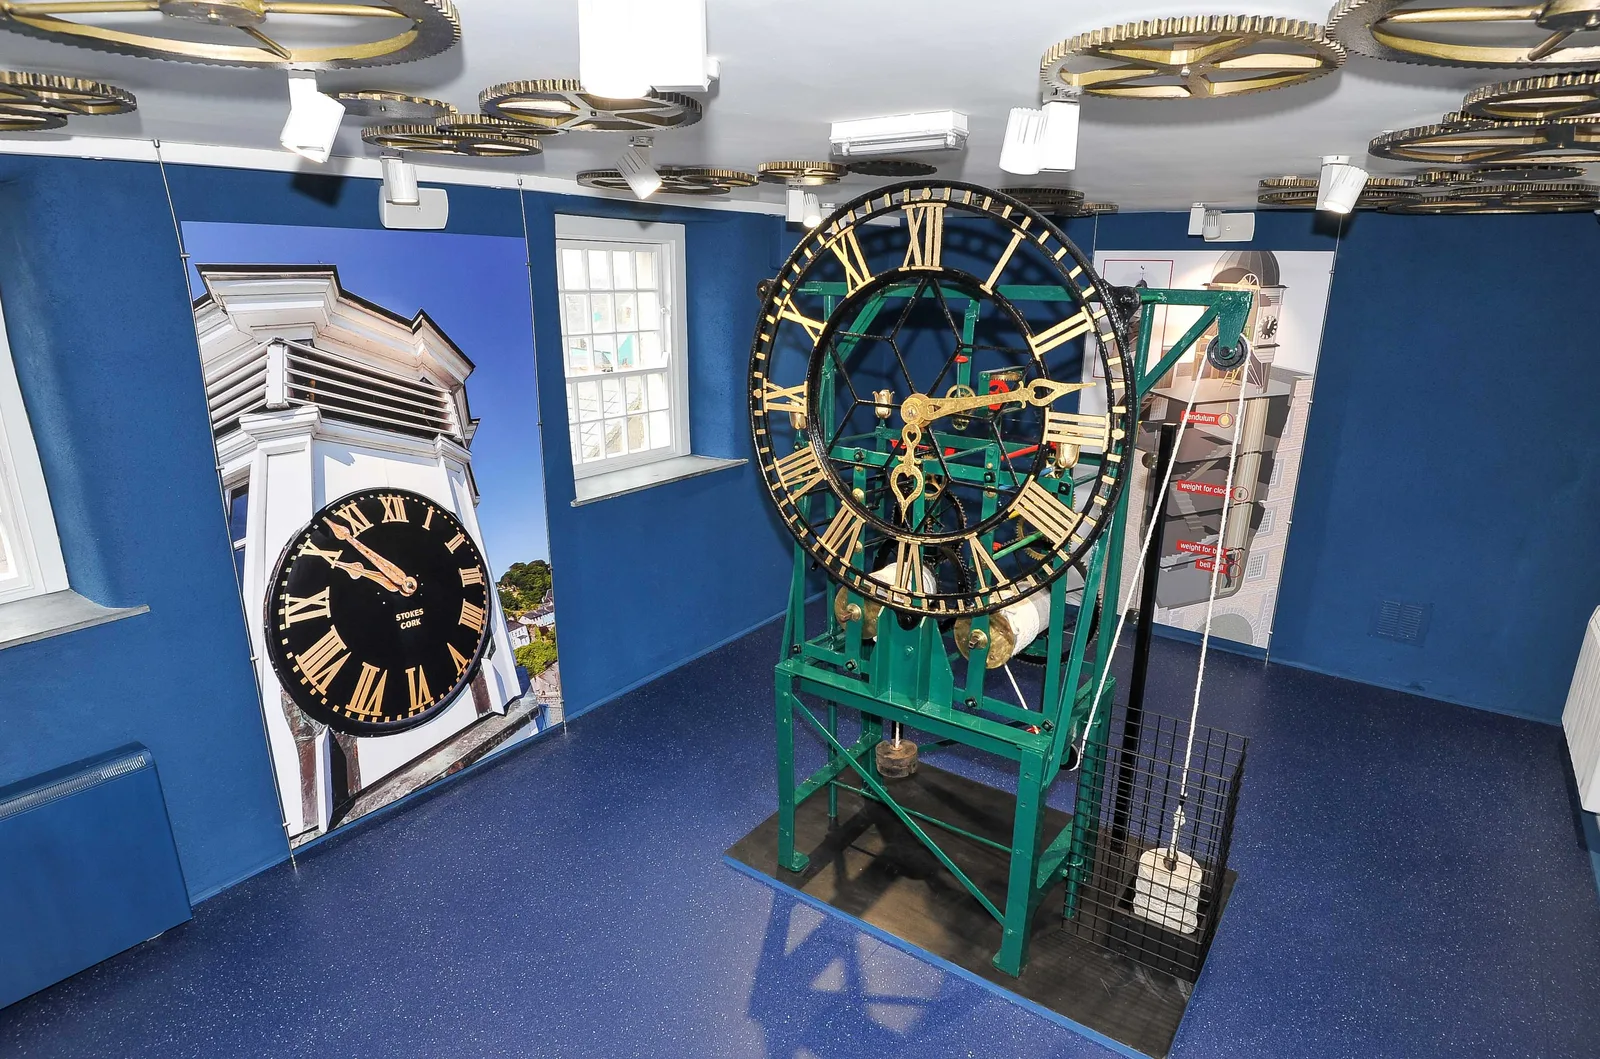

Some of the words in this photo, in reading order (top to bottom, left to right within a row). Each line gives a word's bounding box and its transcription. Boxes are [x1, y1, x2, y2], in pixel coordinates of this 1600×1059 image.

[898, 203, 947, 271] XII
[1184, 413, 1215, 423] endulum
[1181, 482, 1203, 492] weight
[1203, 484, 1213, 493] for
[377, 496, 410, 524] XII
[1180, 542, 1202, 553] weight
[1202, 545, 1212, 553] for
[1199, 560, 1211, 569] bell
[395, 608, 424, 622] STOKES
[400, 618, 422, 630] CORK
